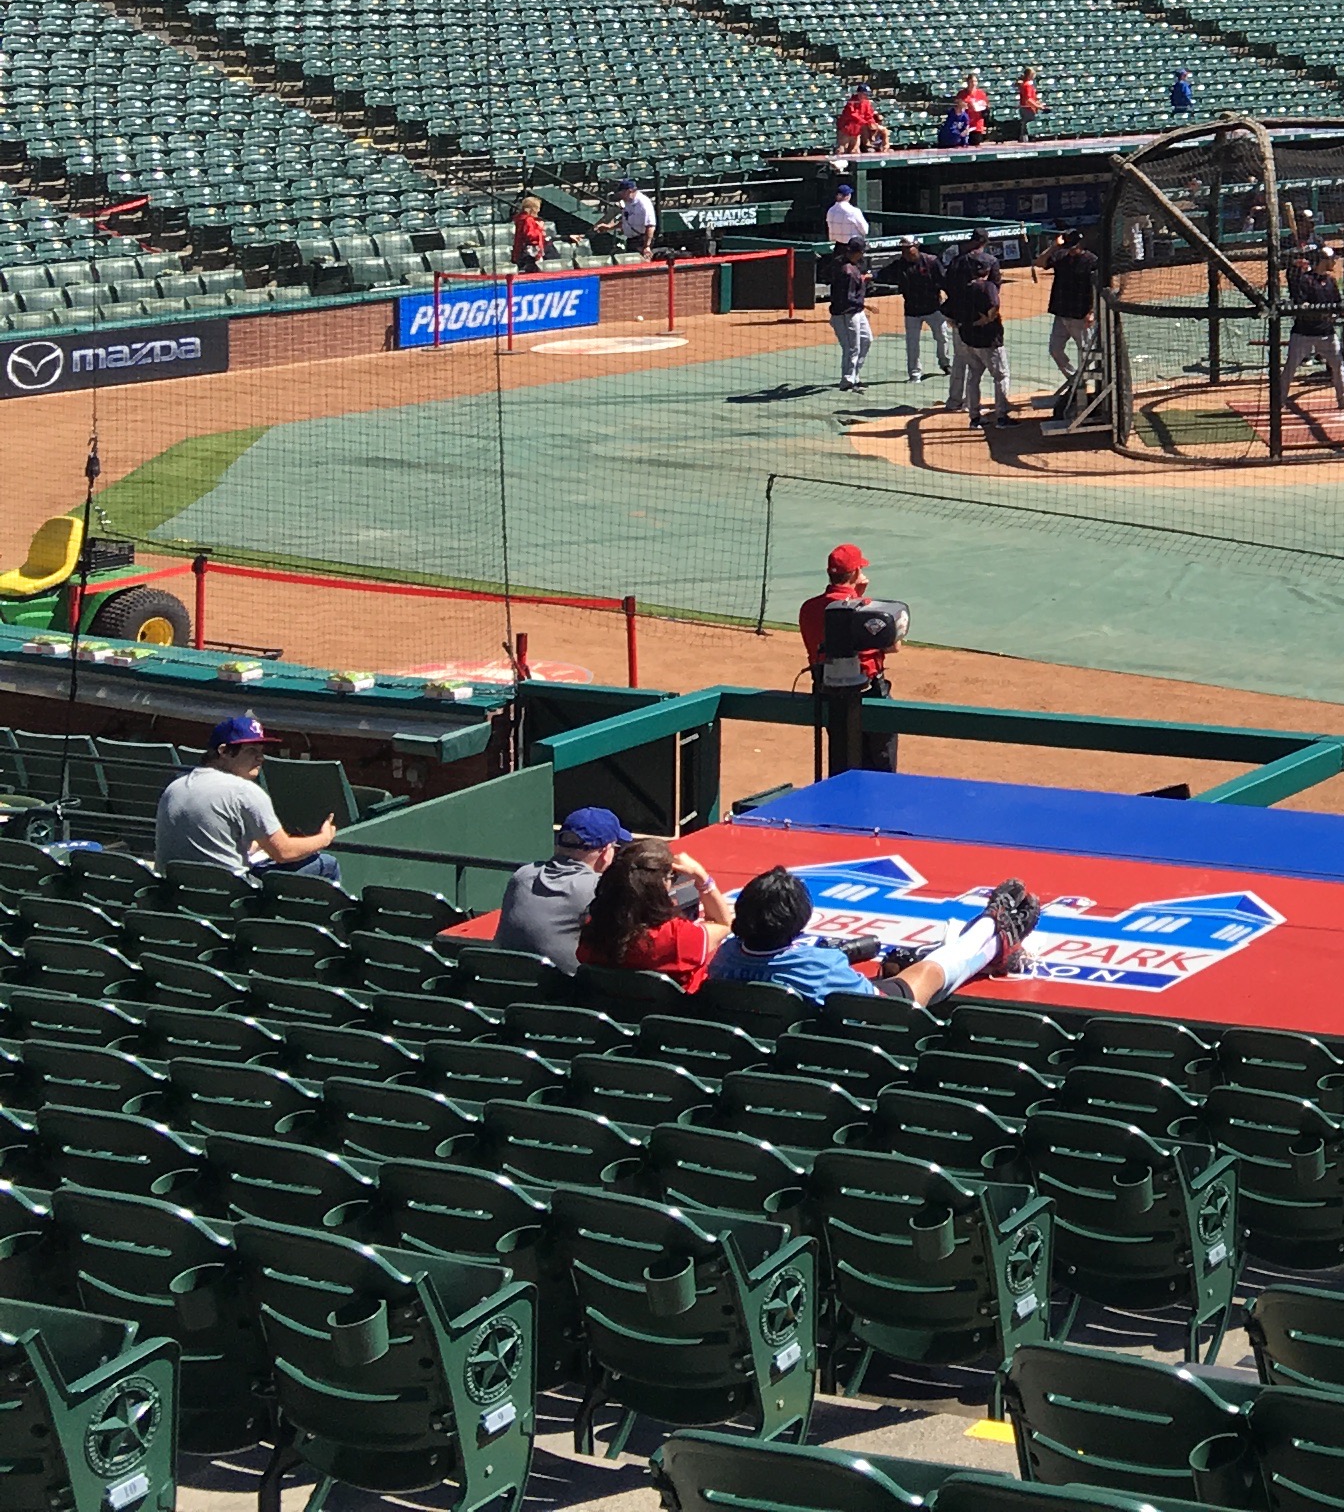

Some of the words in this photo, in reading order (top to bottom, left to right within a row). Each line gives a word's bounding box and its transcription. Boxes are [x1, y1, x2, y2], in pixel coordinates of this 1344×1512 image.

[699, 207, 757, 222] FANATICS
[409, 288, 584, 336] PROGRESSIVE
[1038, 939, 1214, 972] PARK
